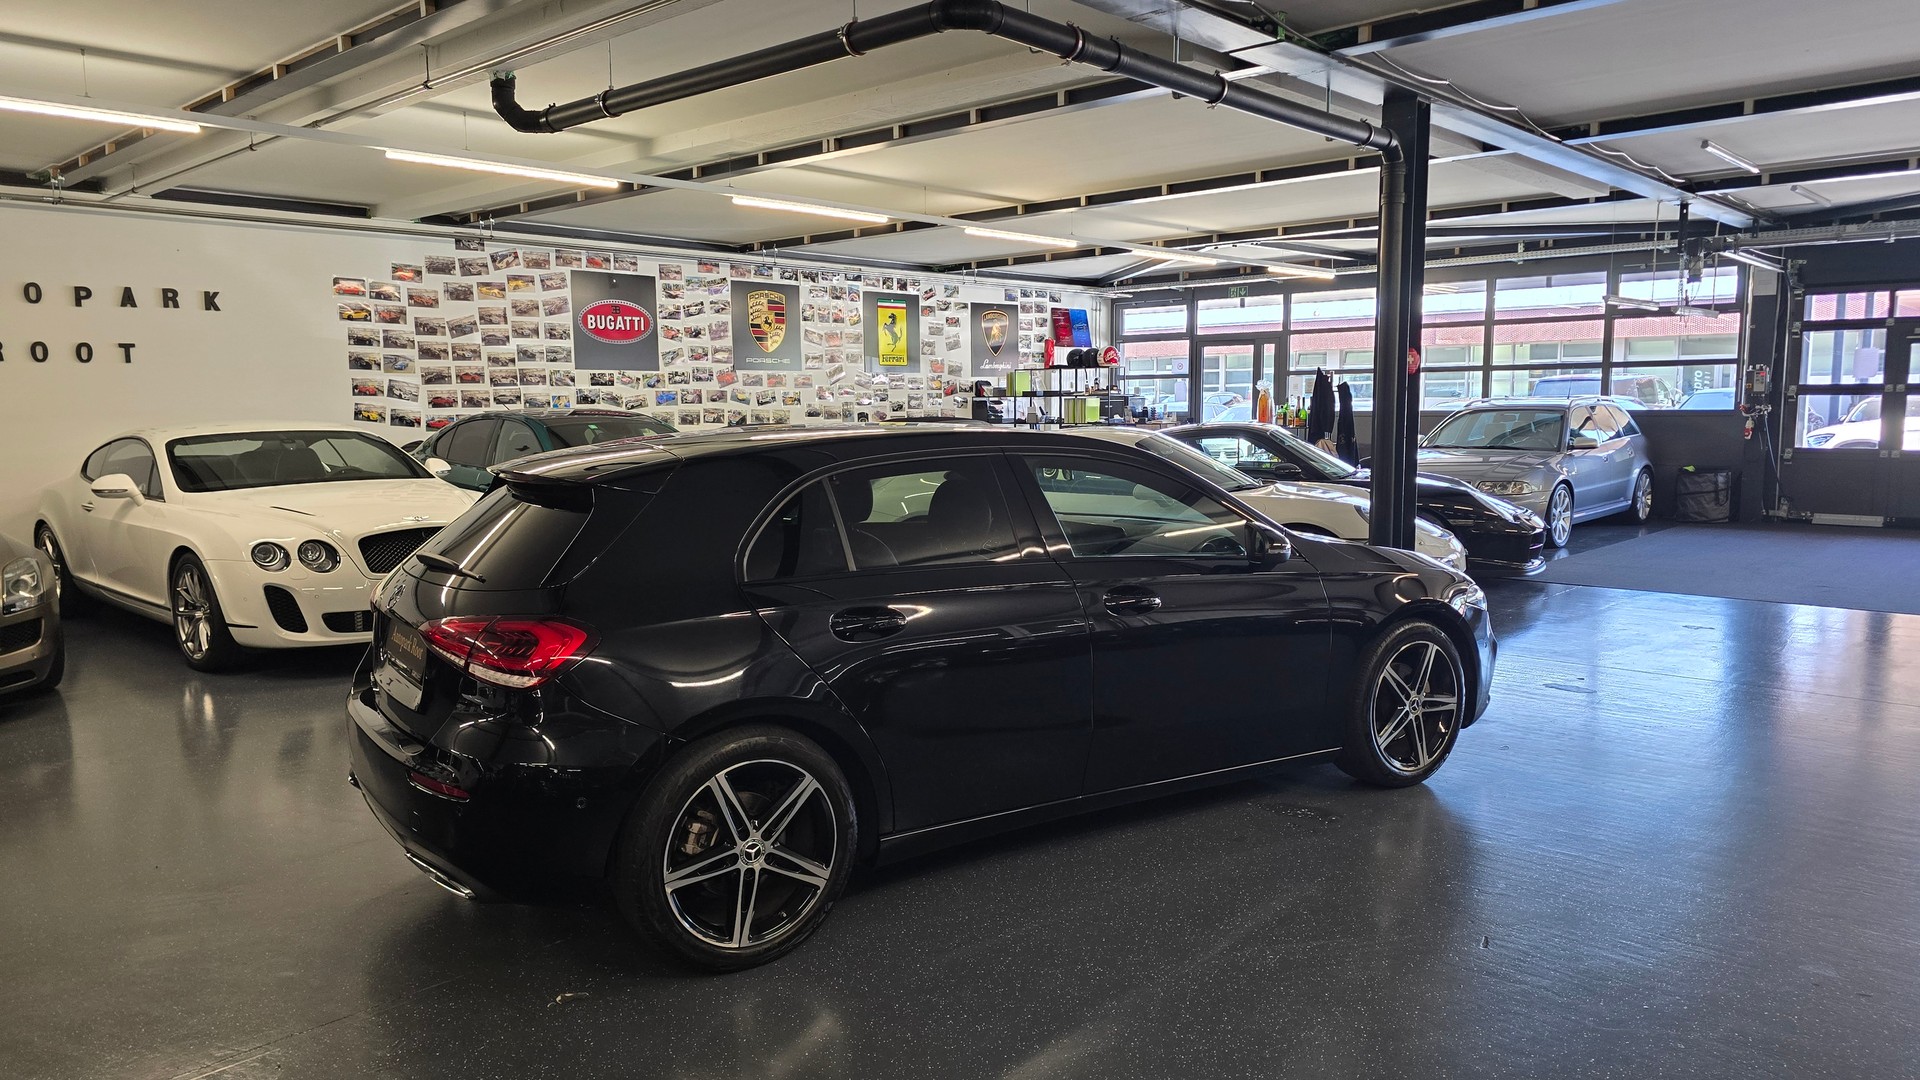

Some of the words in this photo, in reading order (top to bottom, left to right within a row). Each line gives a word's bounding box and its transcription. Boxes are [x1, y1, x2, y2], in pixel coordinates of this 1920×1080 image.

[23, 282, 221, 311] OPARK
[749, 292, 784, 302] PORSCHE
[587, 314, 645, 331] BUGATTI
[0, 341, 136, 363] OOT
[882, 354, 905, 362] Ferrari
[980, 359, 1012, 371] Lamborghini
